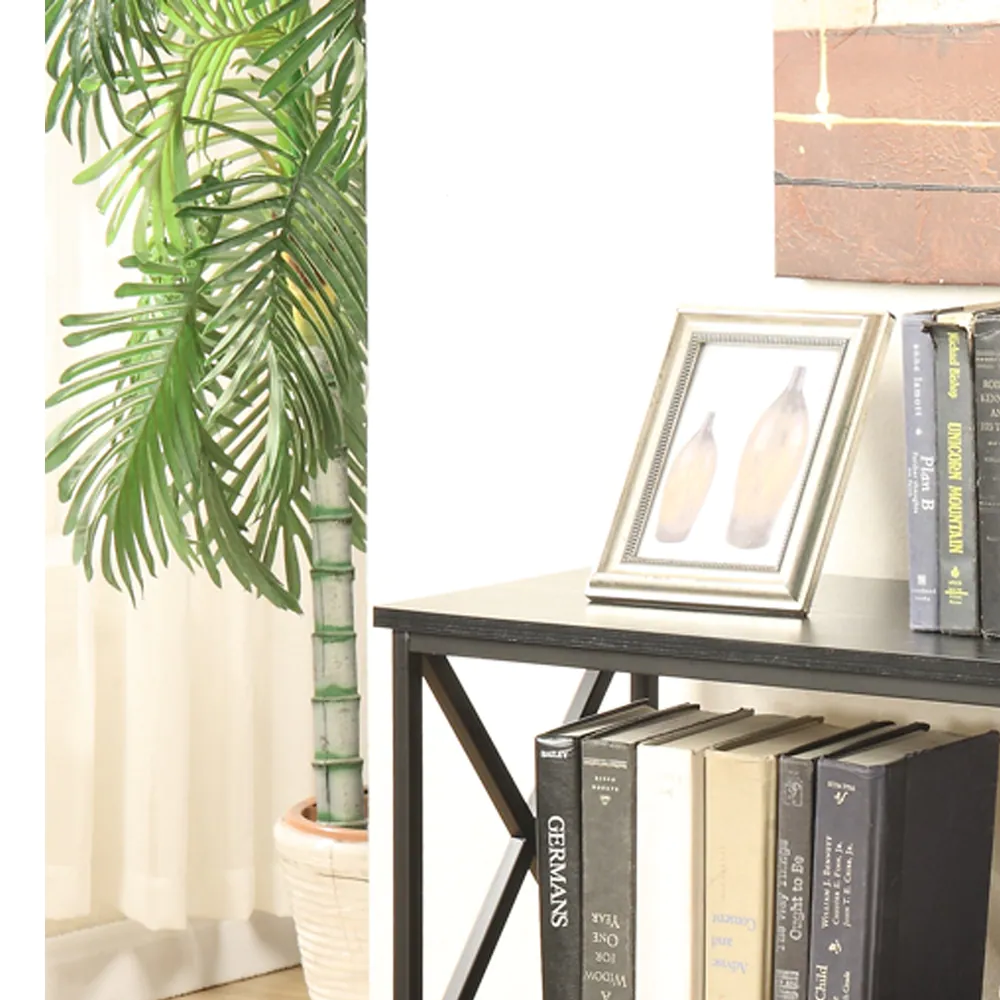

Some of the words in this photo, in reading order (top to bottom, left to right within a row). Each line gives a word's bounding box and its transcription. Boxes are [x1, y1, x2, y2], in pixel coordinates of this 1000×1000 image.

[947, 421, 963, 481] UNICORN
[920, 455, 935, 492] Plan
[921, 498, 935, 512] B
[948, 485, 964, 554] MOUNTAIN
[547, 815, 569, 928] GERMANS
[792, 877, 803, 893] to
[591, 911, 621, 930] YEAR
[592, 931, 620, 948] ONE
[595, 951, 616, 963] FOR
[583, 969, 628, 988] WIDOW
